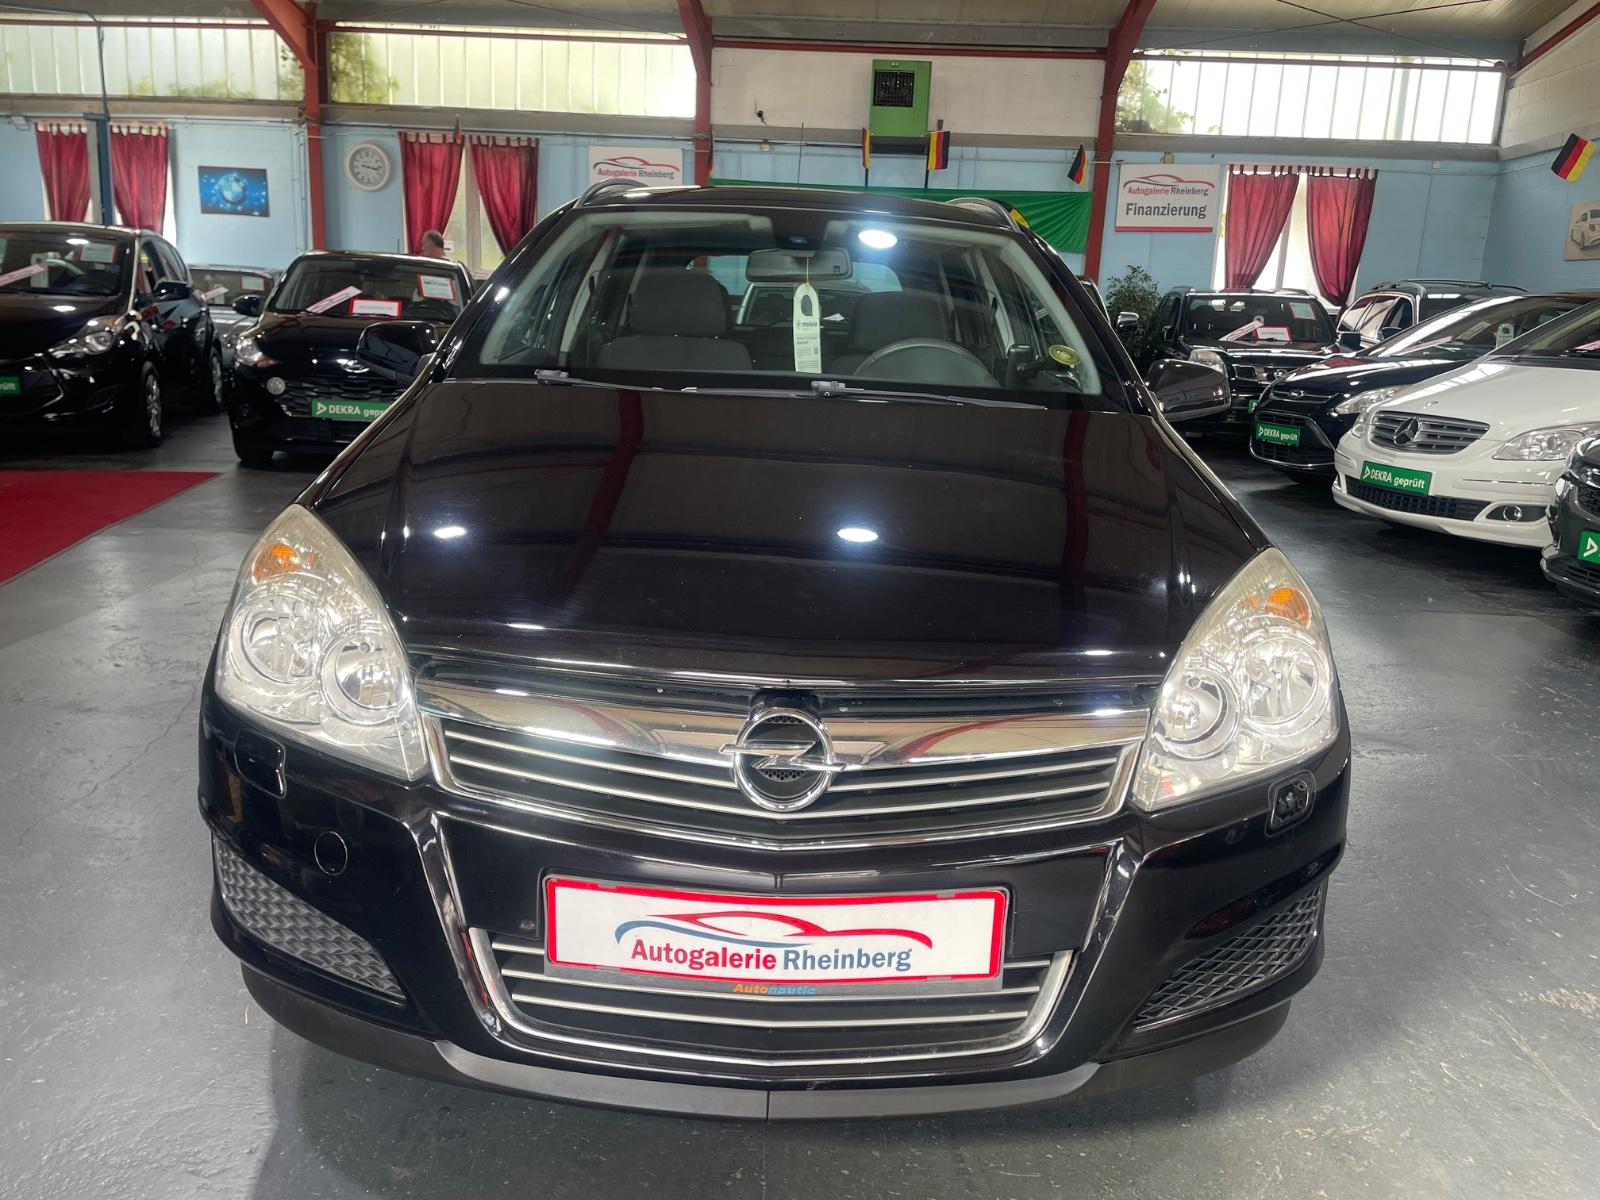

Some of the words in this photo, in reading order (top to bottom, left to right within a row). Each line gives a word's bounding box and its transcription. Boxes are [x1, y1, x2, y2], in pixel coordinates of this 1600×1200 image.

[597, 168, 637, 177] Autogalerie
[638, 169, 674, 179] Rheinberg
[1127, 186, 1169, 196] Autogalerie
[1170, 187, 1209, 196] Rheinberg
[1125, 202, 1207, 219] Finanzierung
[328, 404, 361, 415] DEKRA
[363, 408, 384, 417] gepr
[1263, 428, 1280, 439] DEKRA
[1370, 468, 1392, 483] DEKRA
[1393, 477, 1425, 489] geprüft
[631, 938, 777, 970] Autogalerie
[783, 948, 913, 972] Rheinberg
